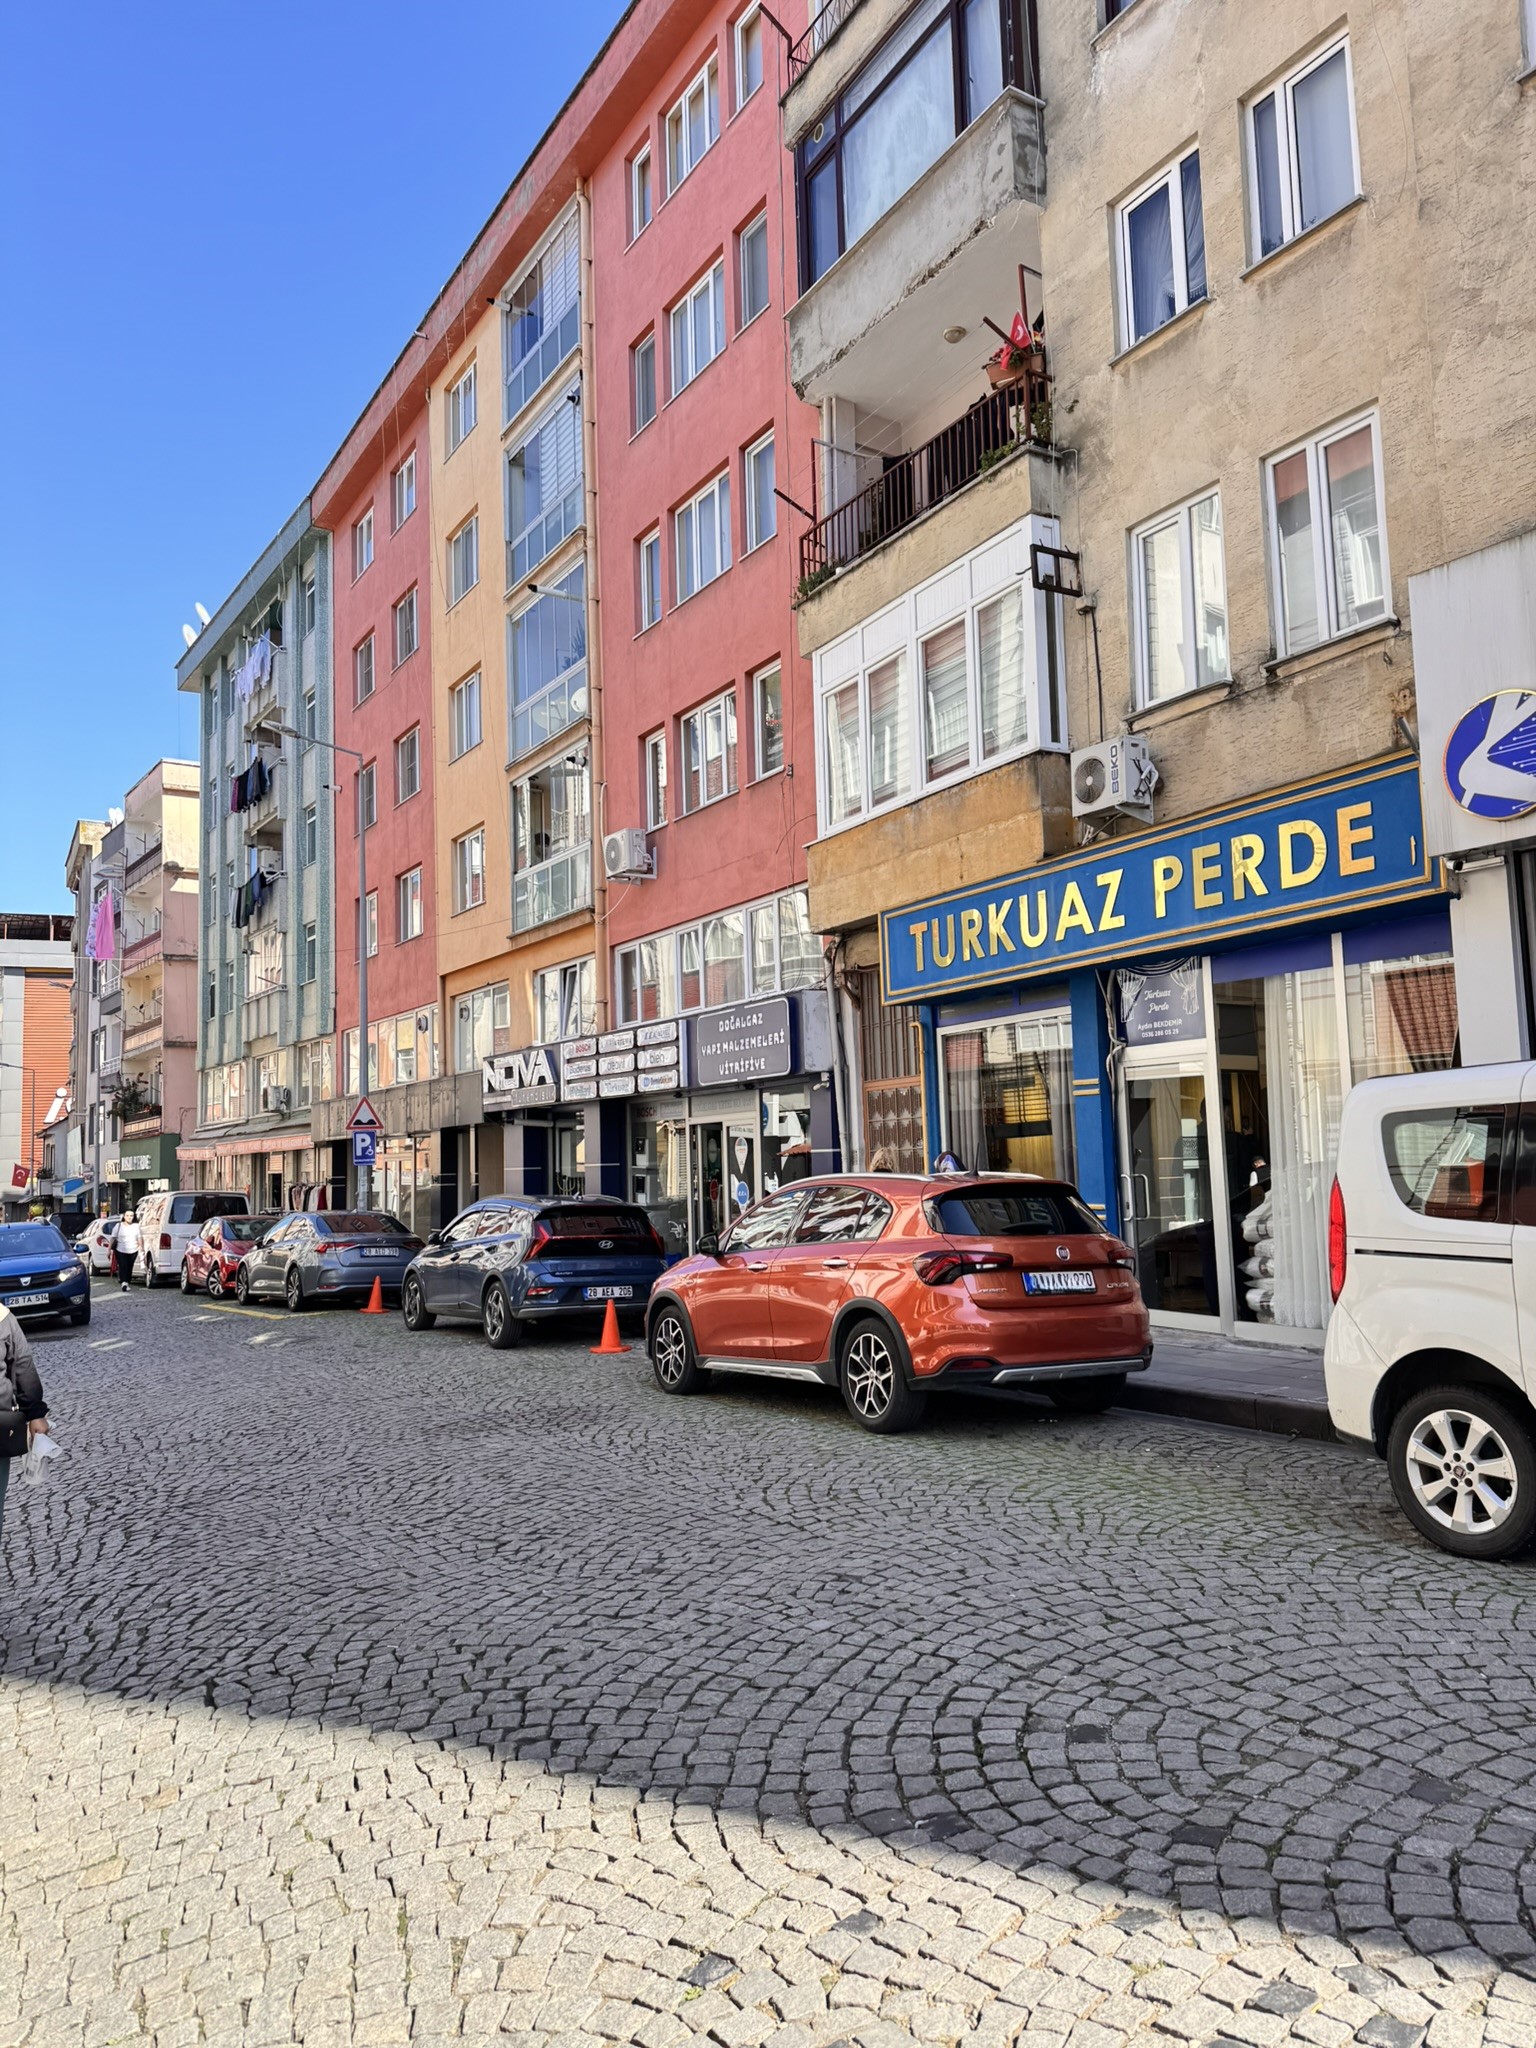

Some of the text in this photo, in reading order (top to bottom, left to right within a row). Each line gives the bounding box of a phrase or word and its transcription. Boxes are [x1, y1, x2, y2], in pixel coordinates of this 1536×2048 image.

[1110, 744, 1120, 794] BEKO
[908, 801, 1376, 973] TURKUAZ PERDE
[1148, 1001, 1170, 1014] Perde
[718, 1012, 764, 1033] DOĞALGAZ
[701, 1027, 785, 1057] YAPI MALZEMELERİ
[483, 1049, 554, 1093] NOVA
[719, 1056, 766, 1076] VİTRİFİYE
[355, 1133, 371, 1156] P
[10, 1296, 20, 1305] 28
[588, 1286, 632, 1297] 28 AEA 206
